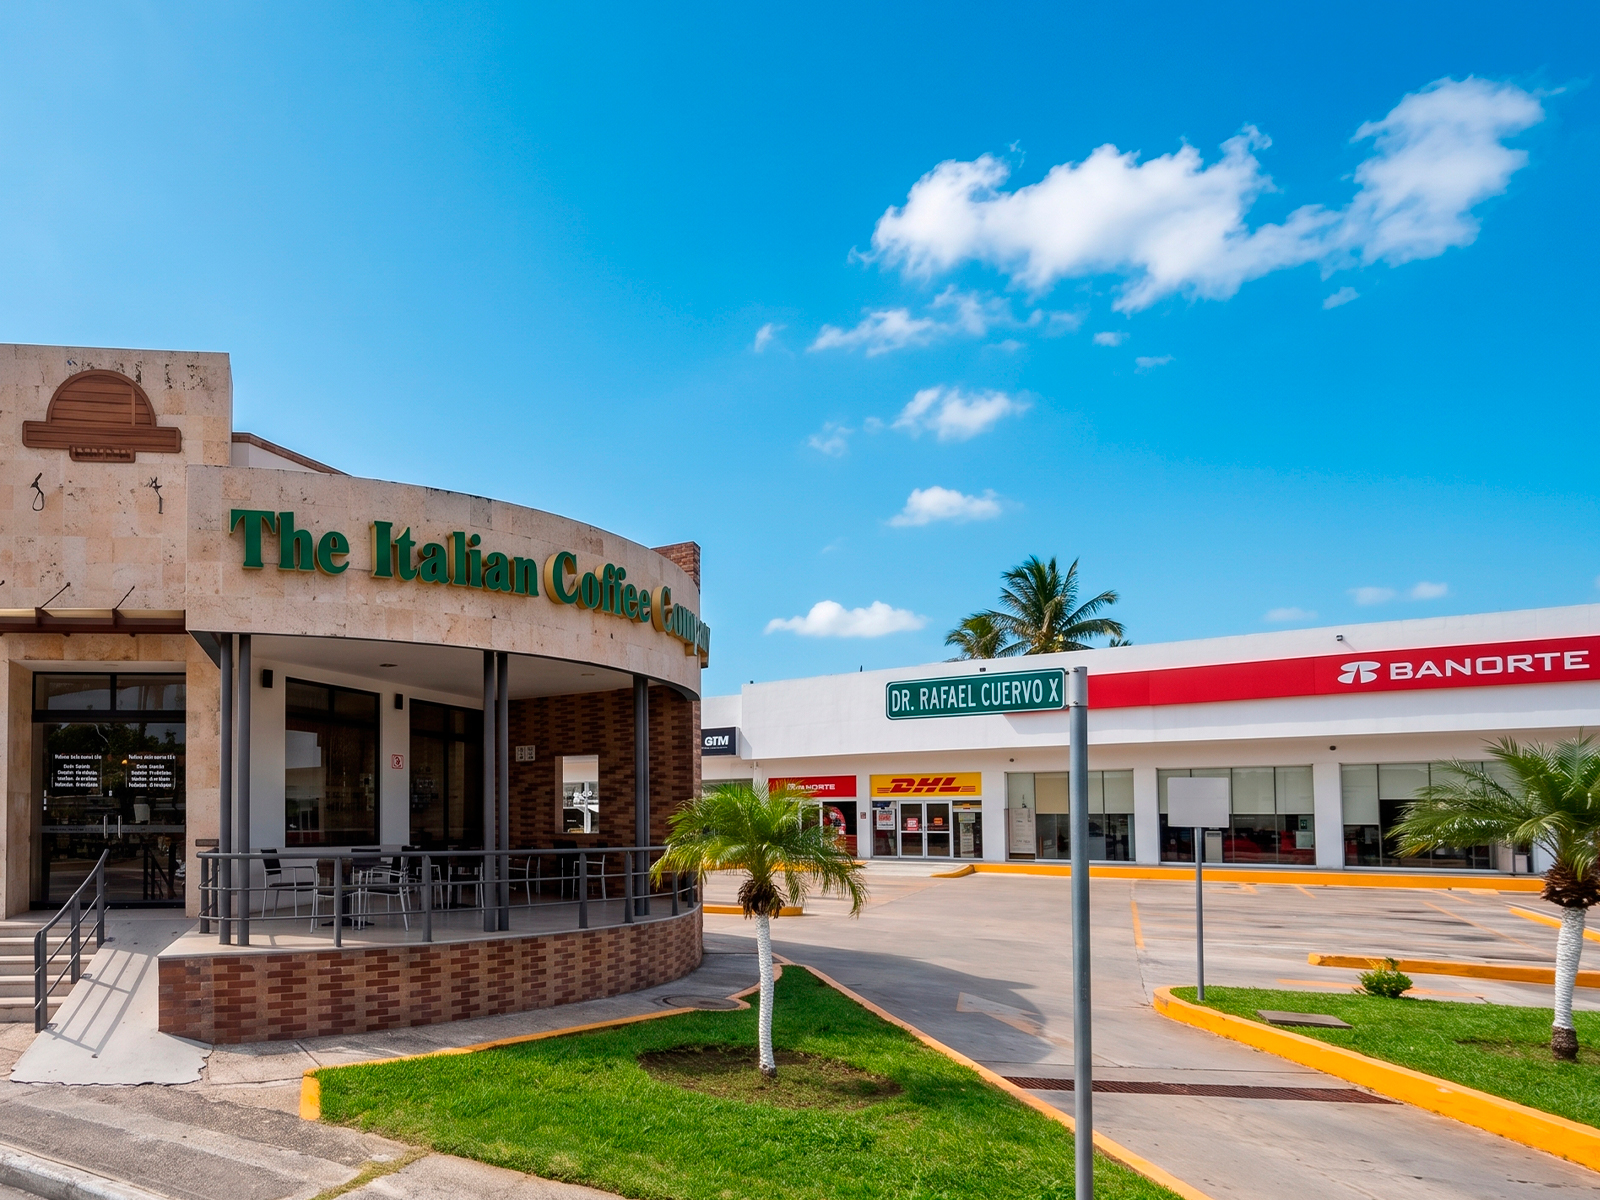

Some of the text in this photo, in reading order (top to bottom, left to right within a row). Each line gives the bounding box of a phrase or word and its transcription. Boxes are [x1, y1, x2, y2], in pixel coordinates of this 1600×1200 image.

[229, 509, 710, 662] The Italian Coffee Comp
[1389, 650, 1591, 681] BANORTE
[892, 678, 1060, 712] DR. RAFAEL CUERVO X
[704, 735, 730, 747] GTM
[889, 777, 962, 794] DHL
